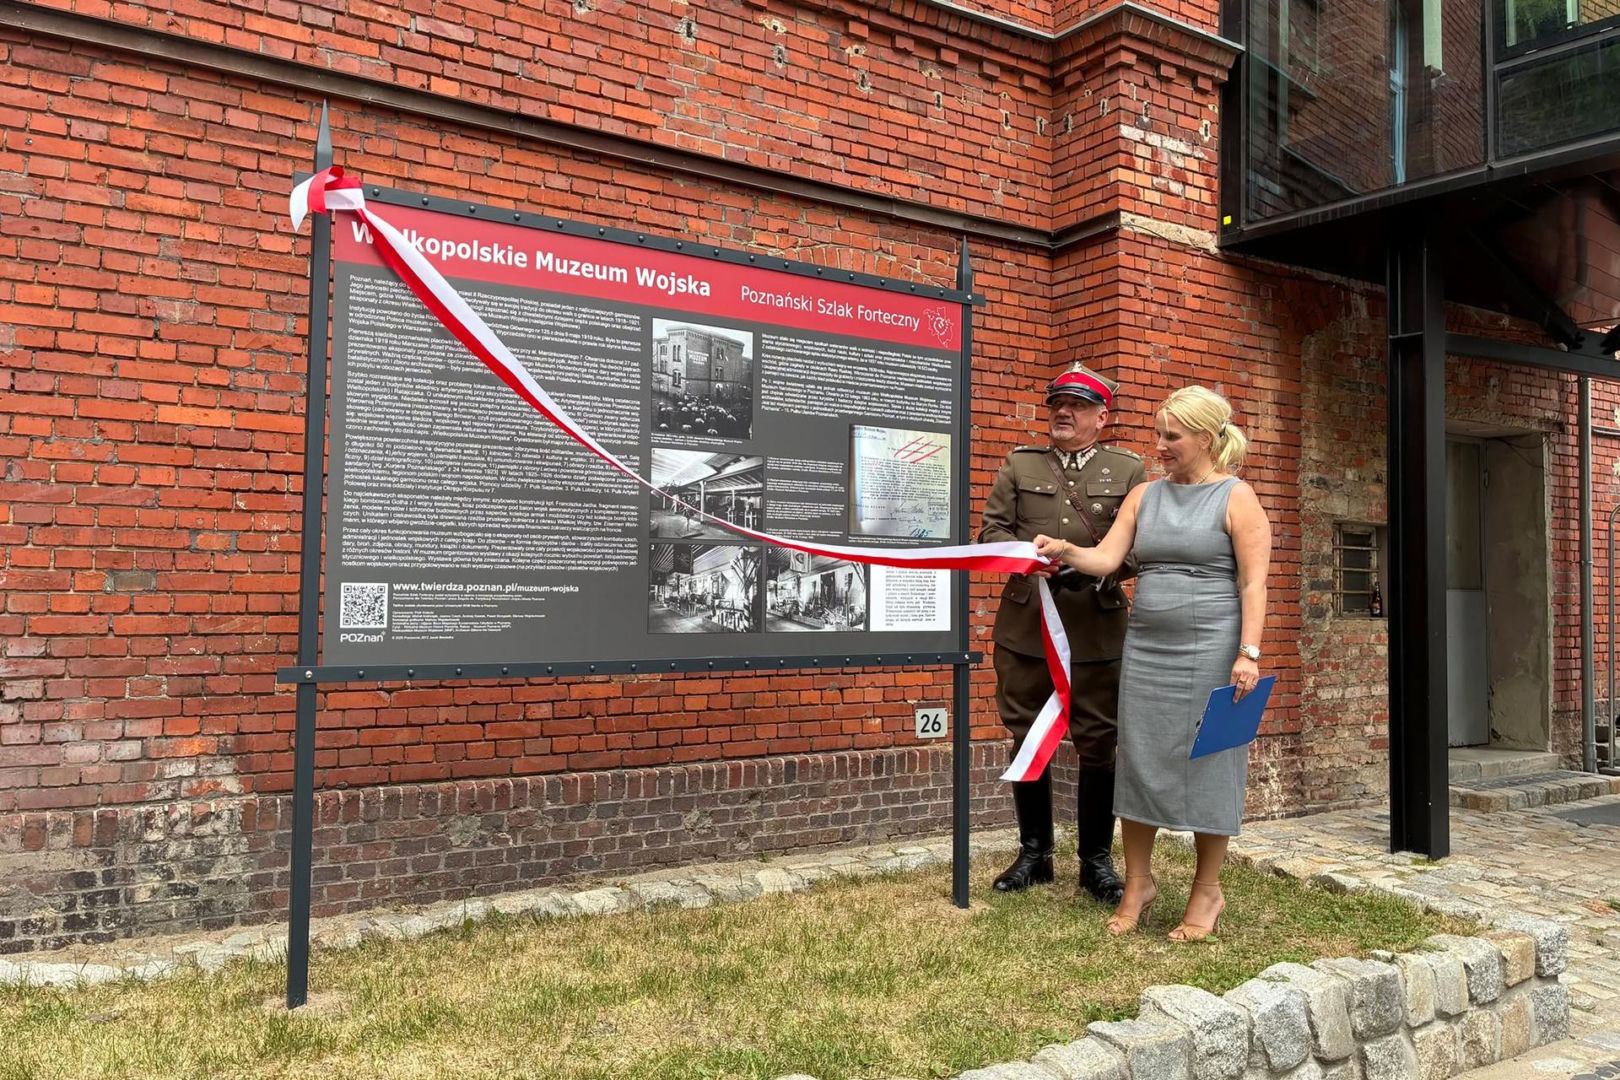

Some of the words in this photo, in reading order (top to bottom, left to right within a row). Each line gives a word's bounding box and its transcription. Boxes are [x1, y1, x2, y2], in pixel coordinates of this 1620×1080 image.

[351, 221, 528, 268] Wlkopolskie
[536, 251, 627, 283] Muzeum
[636, 267, 711, 296] Wojska
[741, 285, 812, 314] Poznański
[818, 298, 853, 318] Szlak
[858, 304, 920, 331] Forteczny
[393, 582, 580, 594] www.twierdza.poznan.pl/muzeum-wojska
[920, 713, 942, 733] 26
